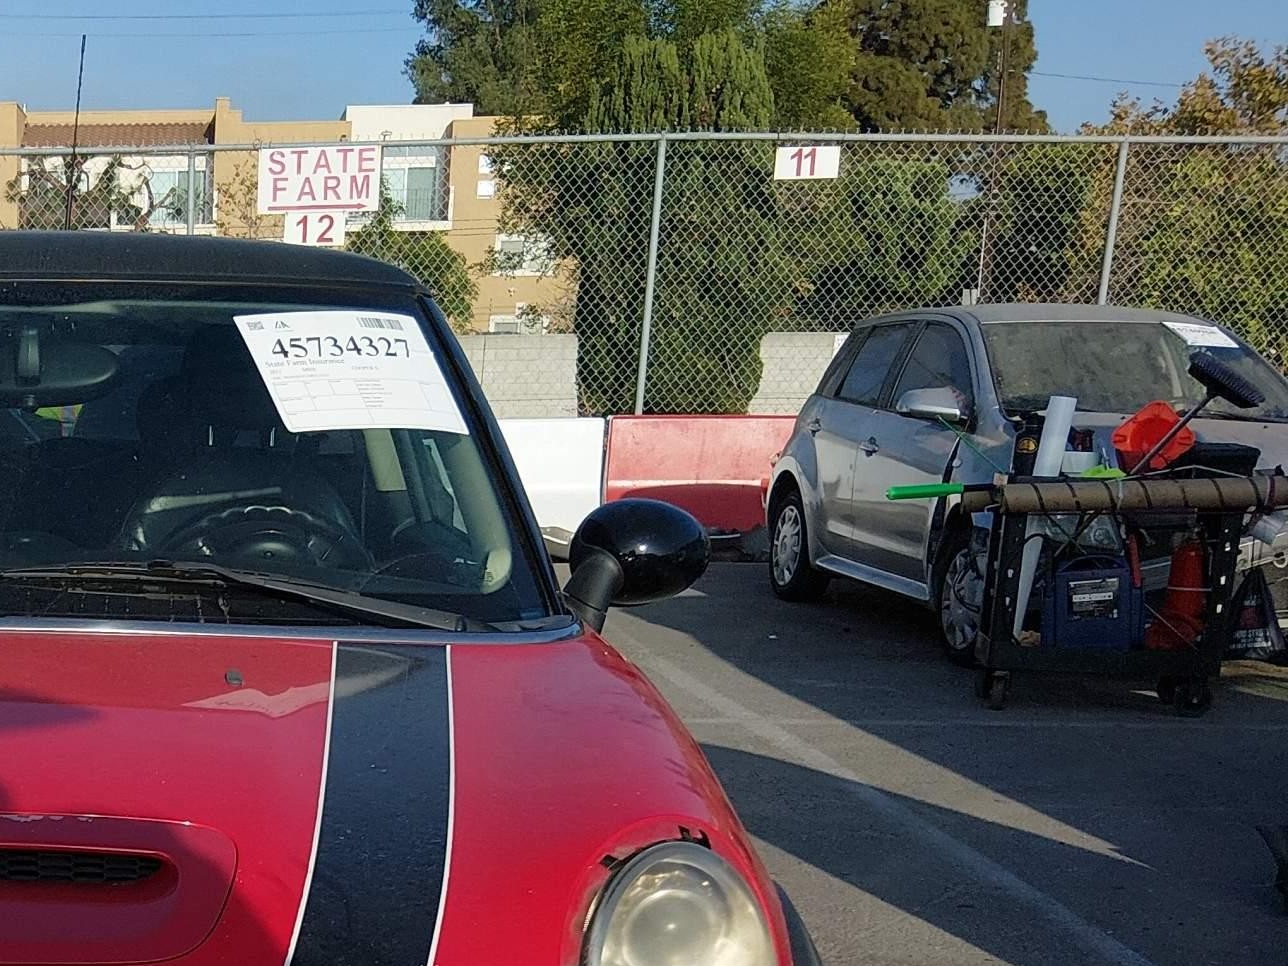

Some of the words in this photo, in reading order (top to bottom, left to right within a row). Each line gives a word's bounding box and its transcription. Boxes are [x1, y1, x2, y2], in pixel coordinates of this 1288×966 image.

[268, 148, 375, 175] STATE
[791, 148, 817, 177] 11
[272, 175, 370, 202] FARM
[296, 214, 335, 244] 12
[271, 335, 411, 359] 45734327
